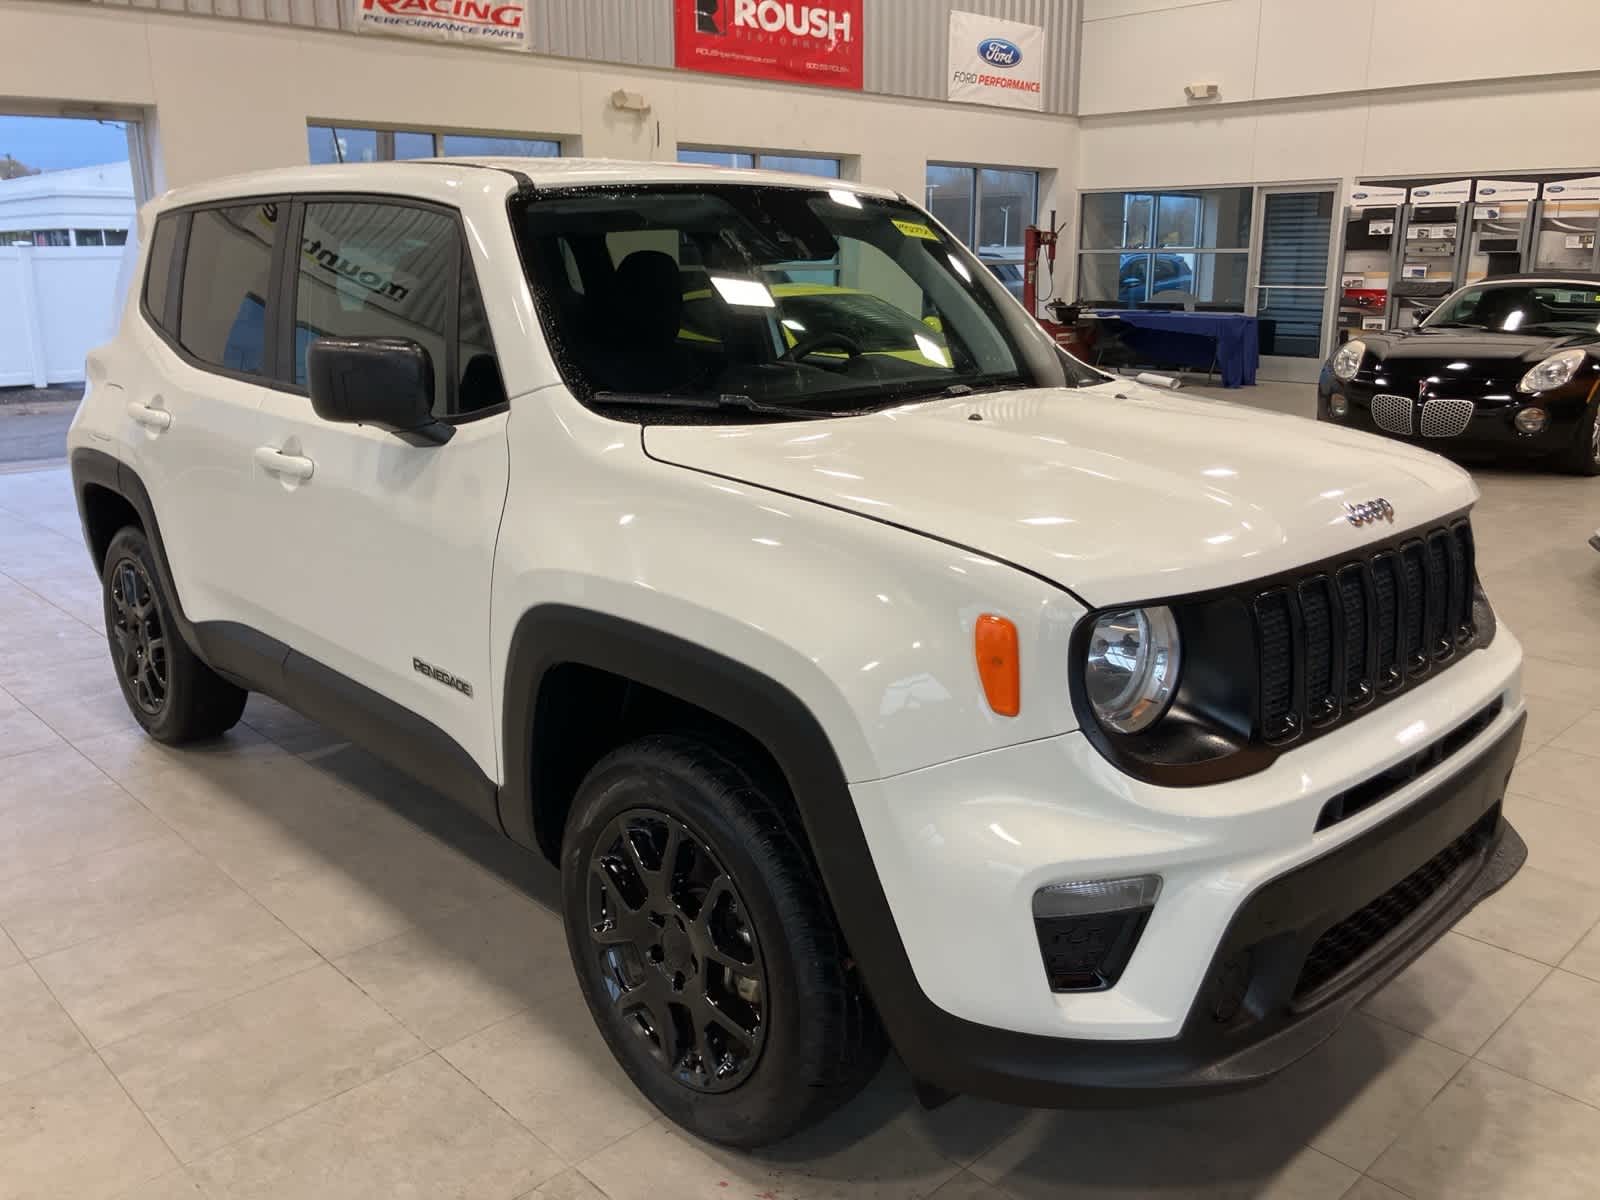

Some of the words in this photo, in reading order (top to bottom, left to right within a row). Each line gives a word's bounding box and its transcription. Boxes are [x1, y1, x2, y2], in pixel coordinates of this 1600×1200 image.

[363, 14, 477, 34] PERFORMANCE
[482, 27, 525, 40] PARTS
[734, 0, 851, 42] ROUSH
[985, 42, 1014, 64] Ford
[953, 71, 977, 84] FORD
[978, 74, 1040, 93] PERFORMANCE
[412, 657, 473, 699] RENEGADE
